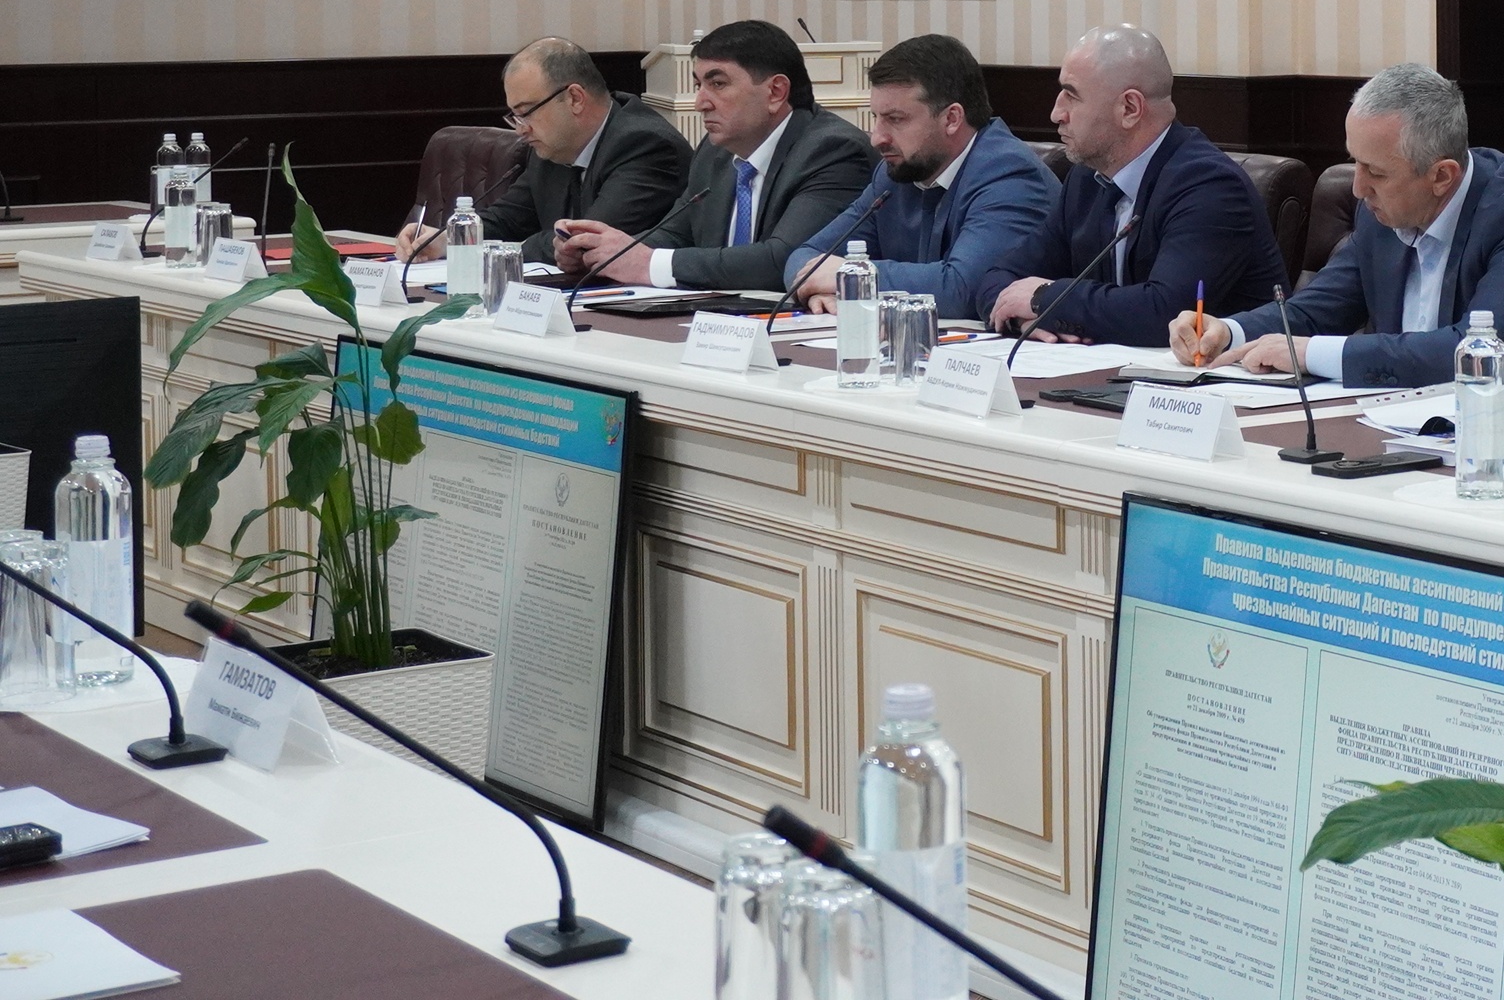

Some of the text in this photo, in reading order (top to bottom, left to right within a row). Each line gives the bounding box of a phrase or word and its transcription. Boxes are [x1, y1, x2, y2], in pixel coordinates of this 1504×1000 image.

[693, 321, 756, 339] ГАДЖИМУРАДОВ
[945, 358, 981, 376] ПАЛЧАЕВ
[1149, 396, 1202, 415] МАЛИКОВ
[1146, 419, 1163, 430] Табир
[1214, 532, 1264, 562] Правила
[1264, 545, 1333, 577] выделения
[1334, 557, 1411, 594] бюджетных
[1411, 573, 1504, 613] ассигнований
[1201, 555, 1288, 595] Правительства
[1288, 574, 1361, 611] Республики
[1361, 590, 1420, 625] Дагестан
[1422, 606, 1440, 628] по
[1230, 588, 1321, 629] чрезвычайных
[1320, 609, 1379, 643] ситуаций
[1379, 625, 1390, 644] и
[1390, 624, 1478, 666] последствий
[218, 660, 277, 700] ГАМЗАТОВ
[1186, 692, 1246, 716] ПОСТАНОВЛЕНИЕ
[1328, 714, 1366, 731] ВЫДЕЛЕНИЯ
[1365, 723, 1408, 742] БЮДЖЕТНЫХ
[1407, 733, 1460, 756] АССИГНОВАНИЙ
[1401, 723, 1431, 738] ПРАВИЛА
[1335, 735, 1395, 759] ПРЕДУПРЕЖДЕНИЮ
[1399, 752, 1443, 773] ЛИКВИДАЦИИ
[1335, 744, 1369, 762] СИТУАЦИЙ
[1374, 754, 1420, 776] ПОСЛЕДСТВИЙ
[1336, 725, 1498, 777] ФОНДА ПРАВИТЕЛЬСТВА РЕСПУБЛИКИ ДАГЕСТАН ПО
